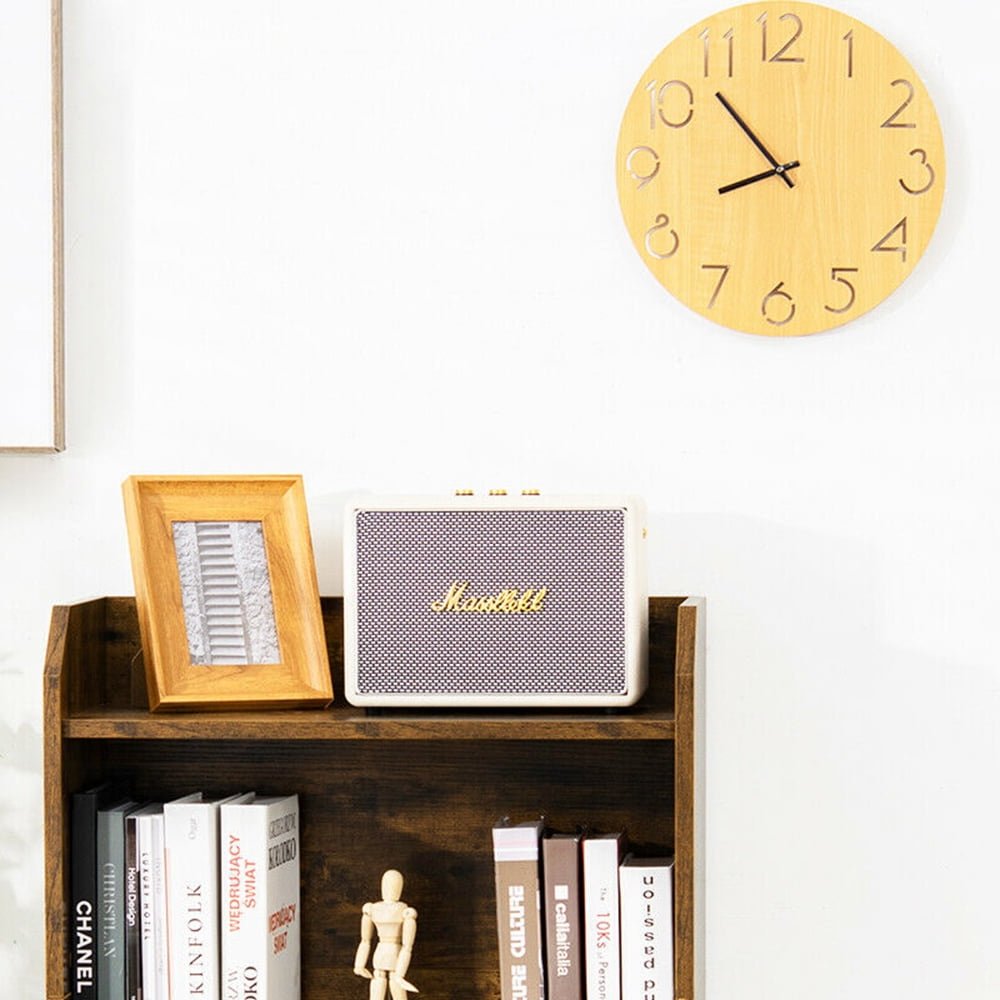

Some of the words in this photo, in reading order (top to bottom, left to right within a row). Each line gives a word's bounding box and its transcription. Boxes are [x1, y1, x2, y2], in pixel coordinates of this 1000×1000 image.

[699, 28, 734, 78] 11
[757, 11, 805, 62] 12
[843, 29, 853, 78] 1
[646, 79, 694, 129] 10
[880, 79, 916, 128] 2
[626, 146, 660, 190] 9
[899, 148, 935, 195] 3
[645, 213, 679, 259] 8
[871, 216, 907, 262] 4
[701, 264, 731, 309] 7
[762, 281, 795, 326] 6
[825, 267, 858, 313] 5
[127, 867, 137, 894] Hotel
[229, 834, 242, 932] WĘDRUJĄCY
[243, 859, 257, 909] ŚWIAT
[126, 895, 137, 927] Design
[508, 884, 525, 958] CULTURE
[596, 912, 610, 949] 10Ks
[643, 876, 655, 970] passion
[76, 900, 93, 994] CHANEL
[188, 883, 204, 995] KINFOLK
